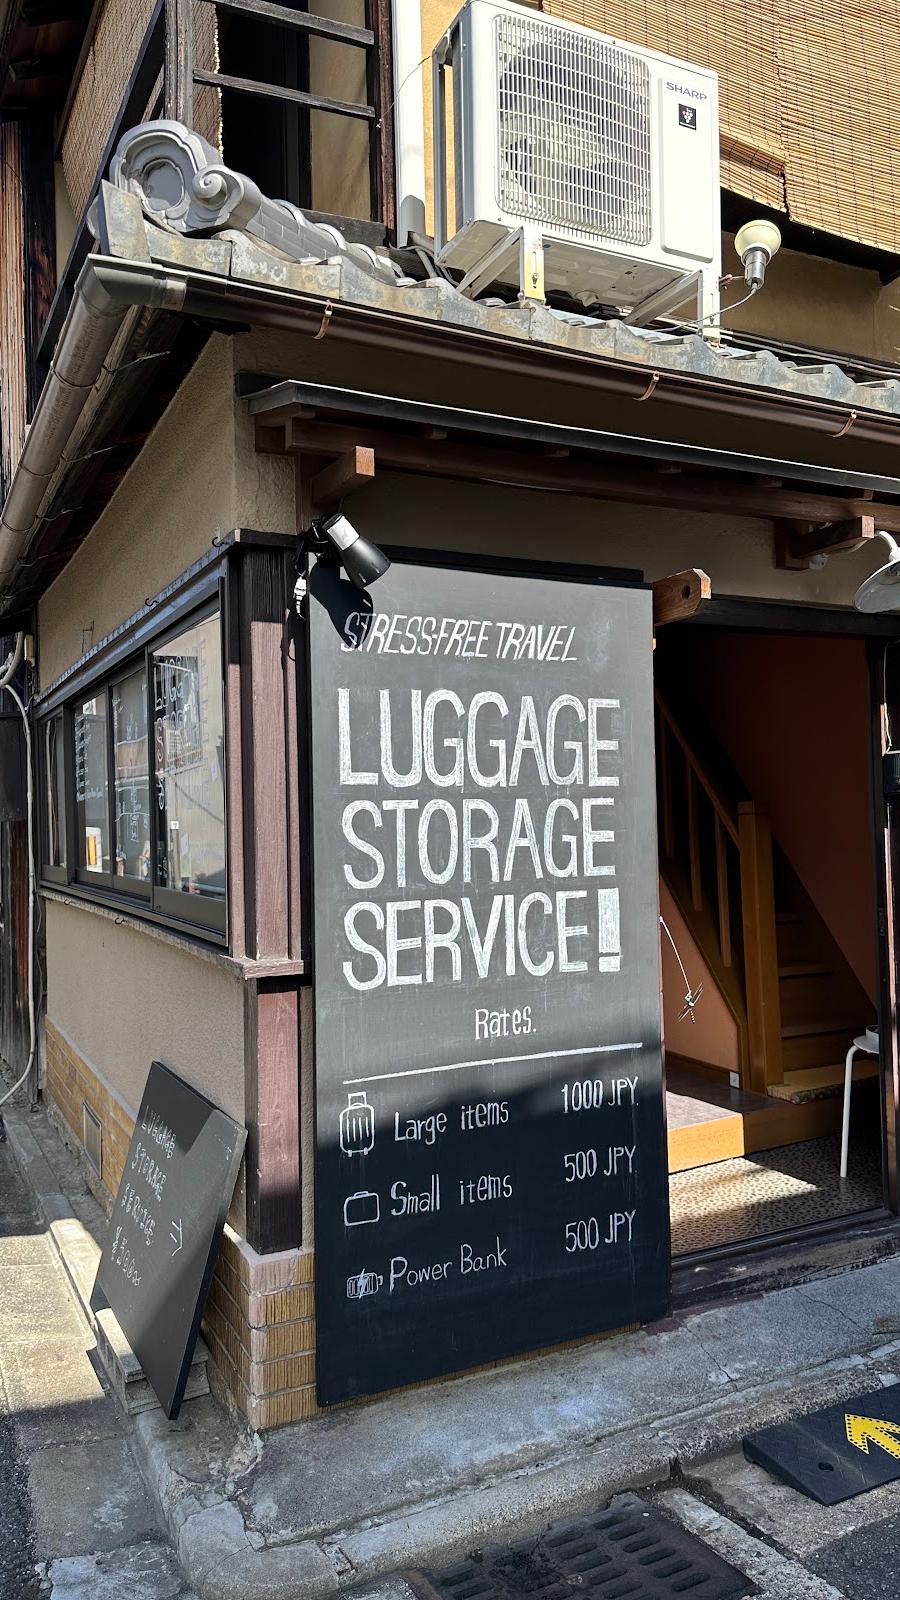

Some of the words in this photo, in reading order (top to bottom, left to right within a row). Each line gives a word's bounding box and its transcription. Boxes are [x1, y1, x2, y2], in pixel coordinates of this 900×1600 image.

[666, 82, 708, 101] SHARP
[340, 612, 493, 658] STRESS-FREE
[496, 622, 578, 663] TRAVEL
[337, 688, 621, 790] LUGGAGE
[341, 797, 617, 890] STORAGE
[342, 887, 622, 992] SERVICE!
[474, 1006, 537, 1041] Rates.
[141, 1105, 177, 1159] LUGGAGE
[394, 1111, 448, 1146] Large
[460, 1101, 510, 1131] items
[561, 1079, 604, 1114] 1000
[131, 1142, 167, 1203] STORAGE
[390, 1174, 441, 1217] Small
[459, 1174, 514, 1206] items
[563, 1149, 598, 1182] 500
[388, 1256, 453, 1295] Power
[460, 1236, 508, 1275] Bank
[565, 1216, 600, 1252] 500
[604, 1209, 637, 1244] JPY
